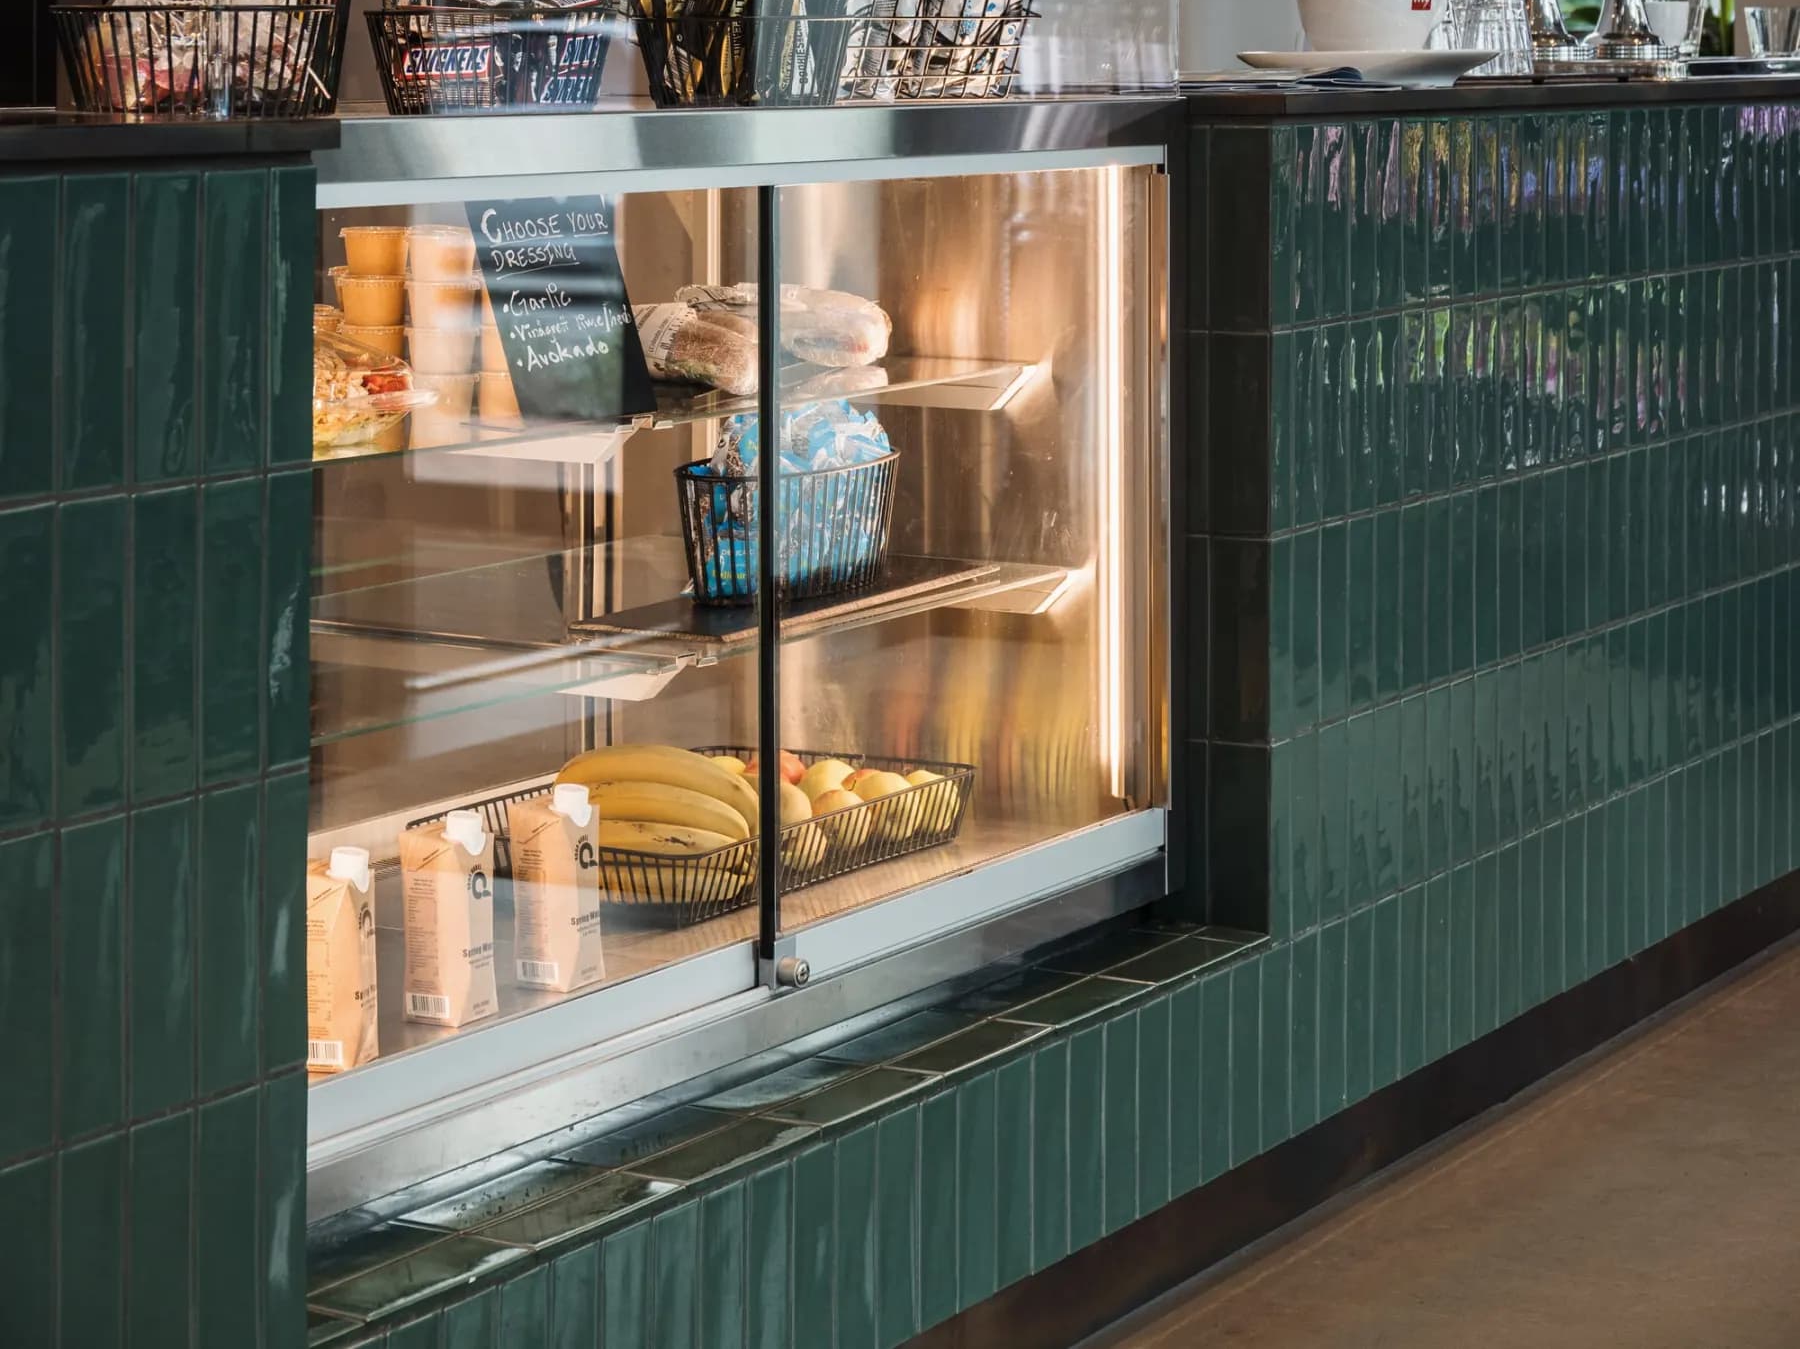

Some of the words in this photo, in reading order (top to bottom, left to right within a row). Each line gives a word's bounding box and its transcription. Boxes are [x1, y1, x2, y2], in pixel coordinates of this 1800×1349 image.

[406, 47, 491, 74] SNICKERS
[481, 208, 561, 243] CHOOSE
[566, 211, 609, 233] YOUR
[490, 242, 577, 273] DRESSING
[527, 337, 609, 372] Avokado
